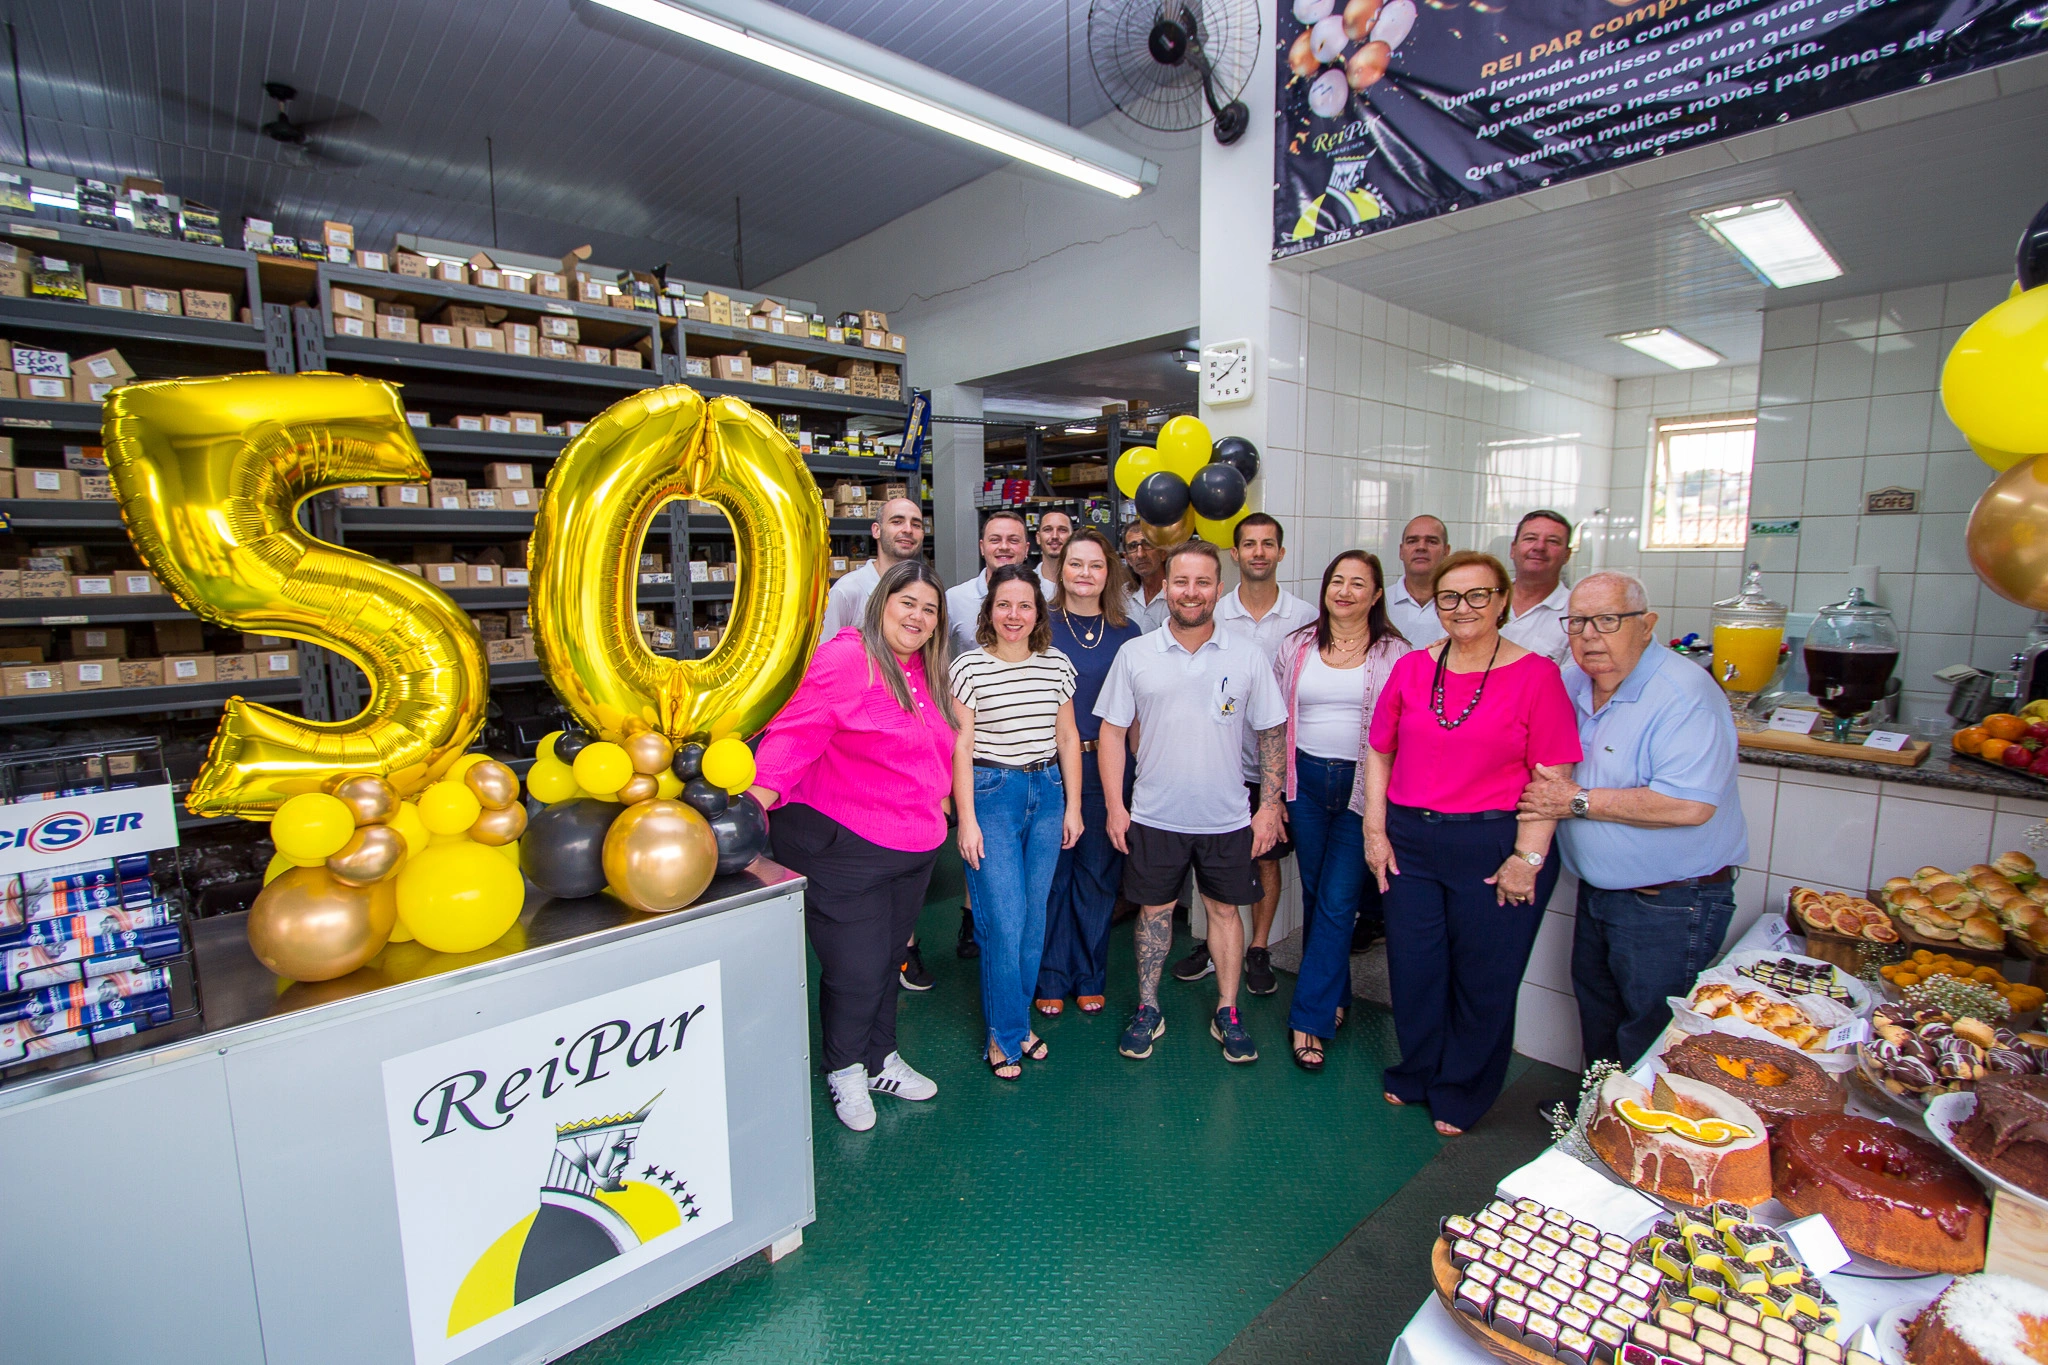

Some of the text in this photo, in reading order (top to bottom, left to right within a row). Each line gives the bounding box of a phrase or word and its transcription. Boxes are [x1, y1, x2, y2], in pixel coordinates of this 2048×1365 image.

[1443, 86, 1486, 111] Uma
[1489, 57, 1574, 97] jornada
[1579, 36, 1630, 65] feita
[1635, 16, 1690, 44] com
[1476, 0, 1897, 140] Agradecemos a cada um que este
[1481, 0, 1692, 79] REI PAR comp
[1490, 101, 1501, 114] e
[1504, 49, 1662, 109] compromisso
[1666, 27, 1723, 56] com
[1729, 20, 1746, 34] a
[1465, 27, 1945, 182] Que venham muitas novas páginas de
[1532, 42, 1826, 141] conosco nessa história.
[1612, 116, 1718, 159] sucesso!
[1323, 228, 1351, 245] 1975
[413, 1005, 705, 1143] ReiPar
